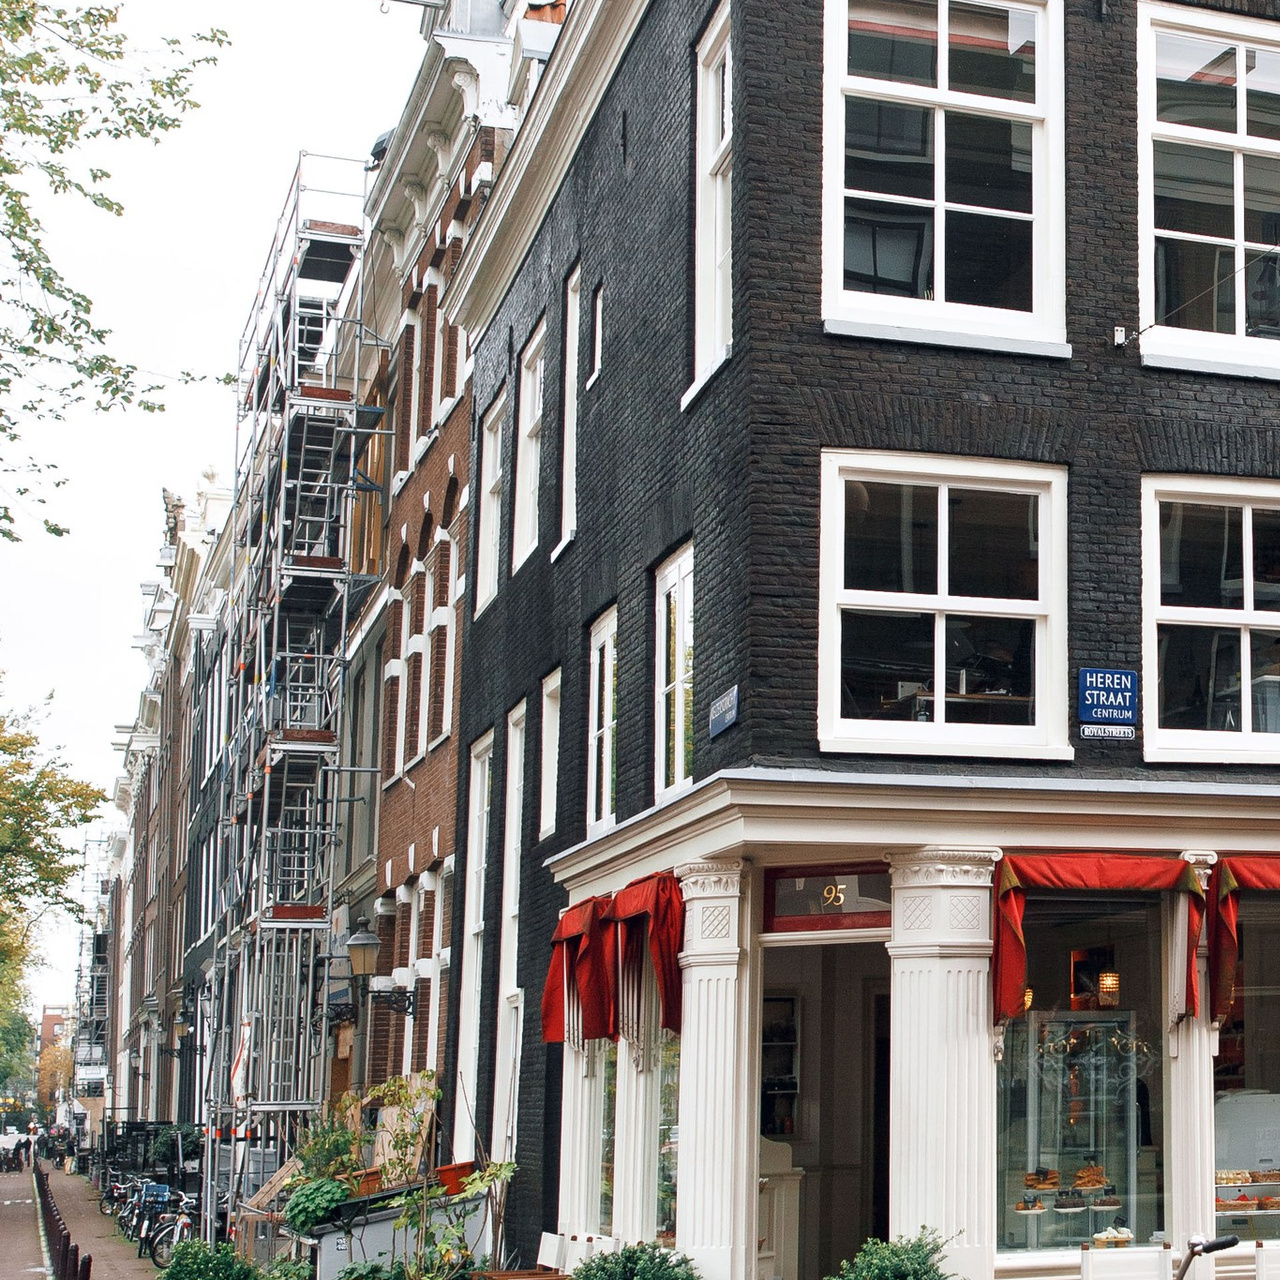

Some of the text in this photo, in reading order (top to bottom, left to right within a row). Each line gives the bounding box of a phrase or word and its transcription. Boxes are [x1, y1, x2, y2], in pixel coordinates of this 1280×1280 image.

[1086, 672, 1131, 689] HEREN
[1085, 690, 1132, 707] STRAAT
[1092, 708, 1132, 719] CENTRUM
[823, 884, 847, 906] 95
